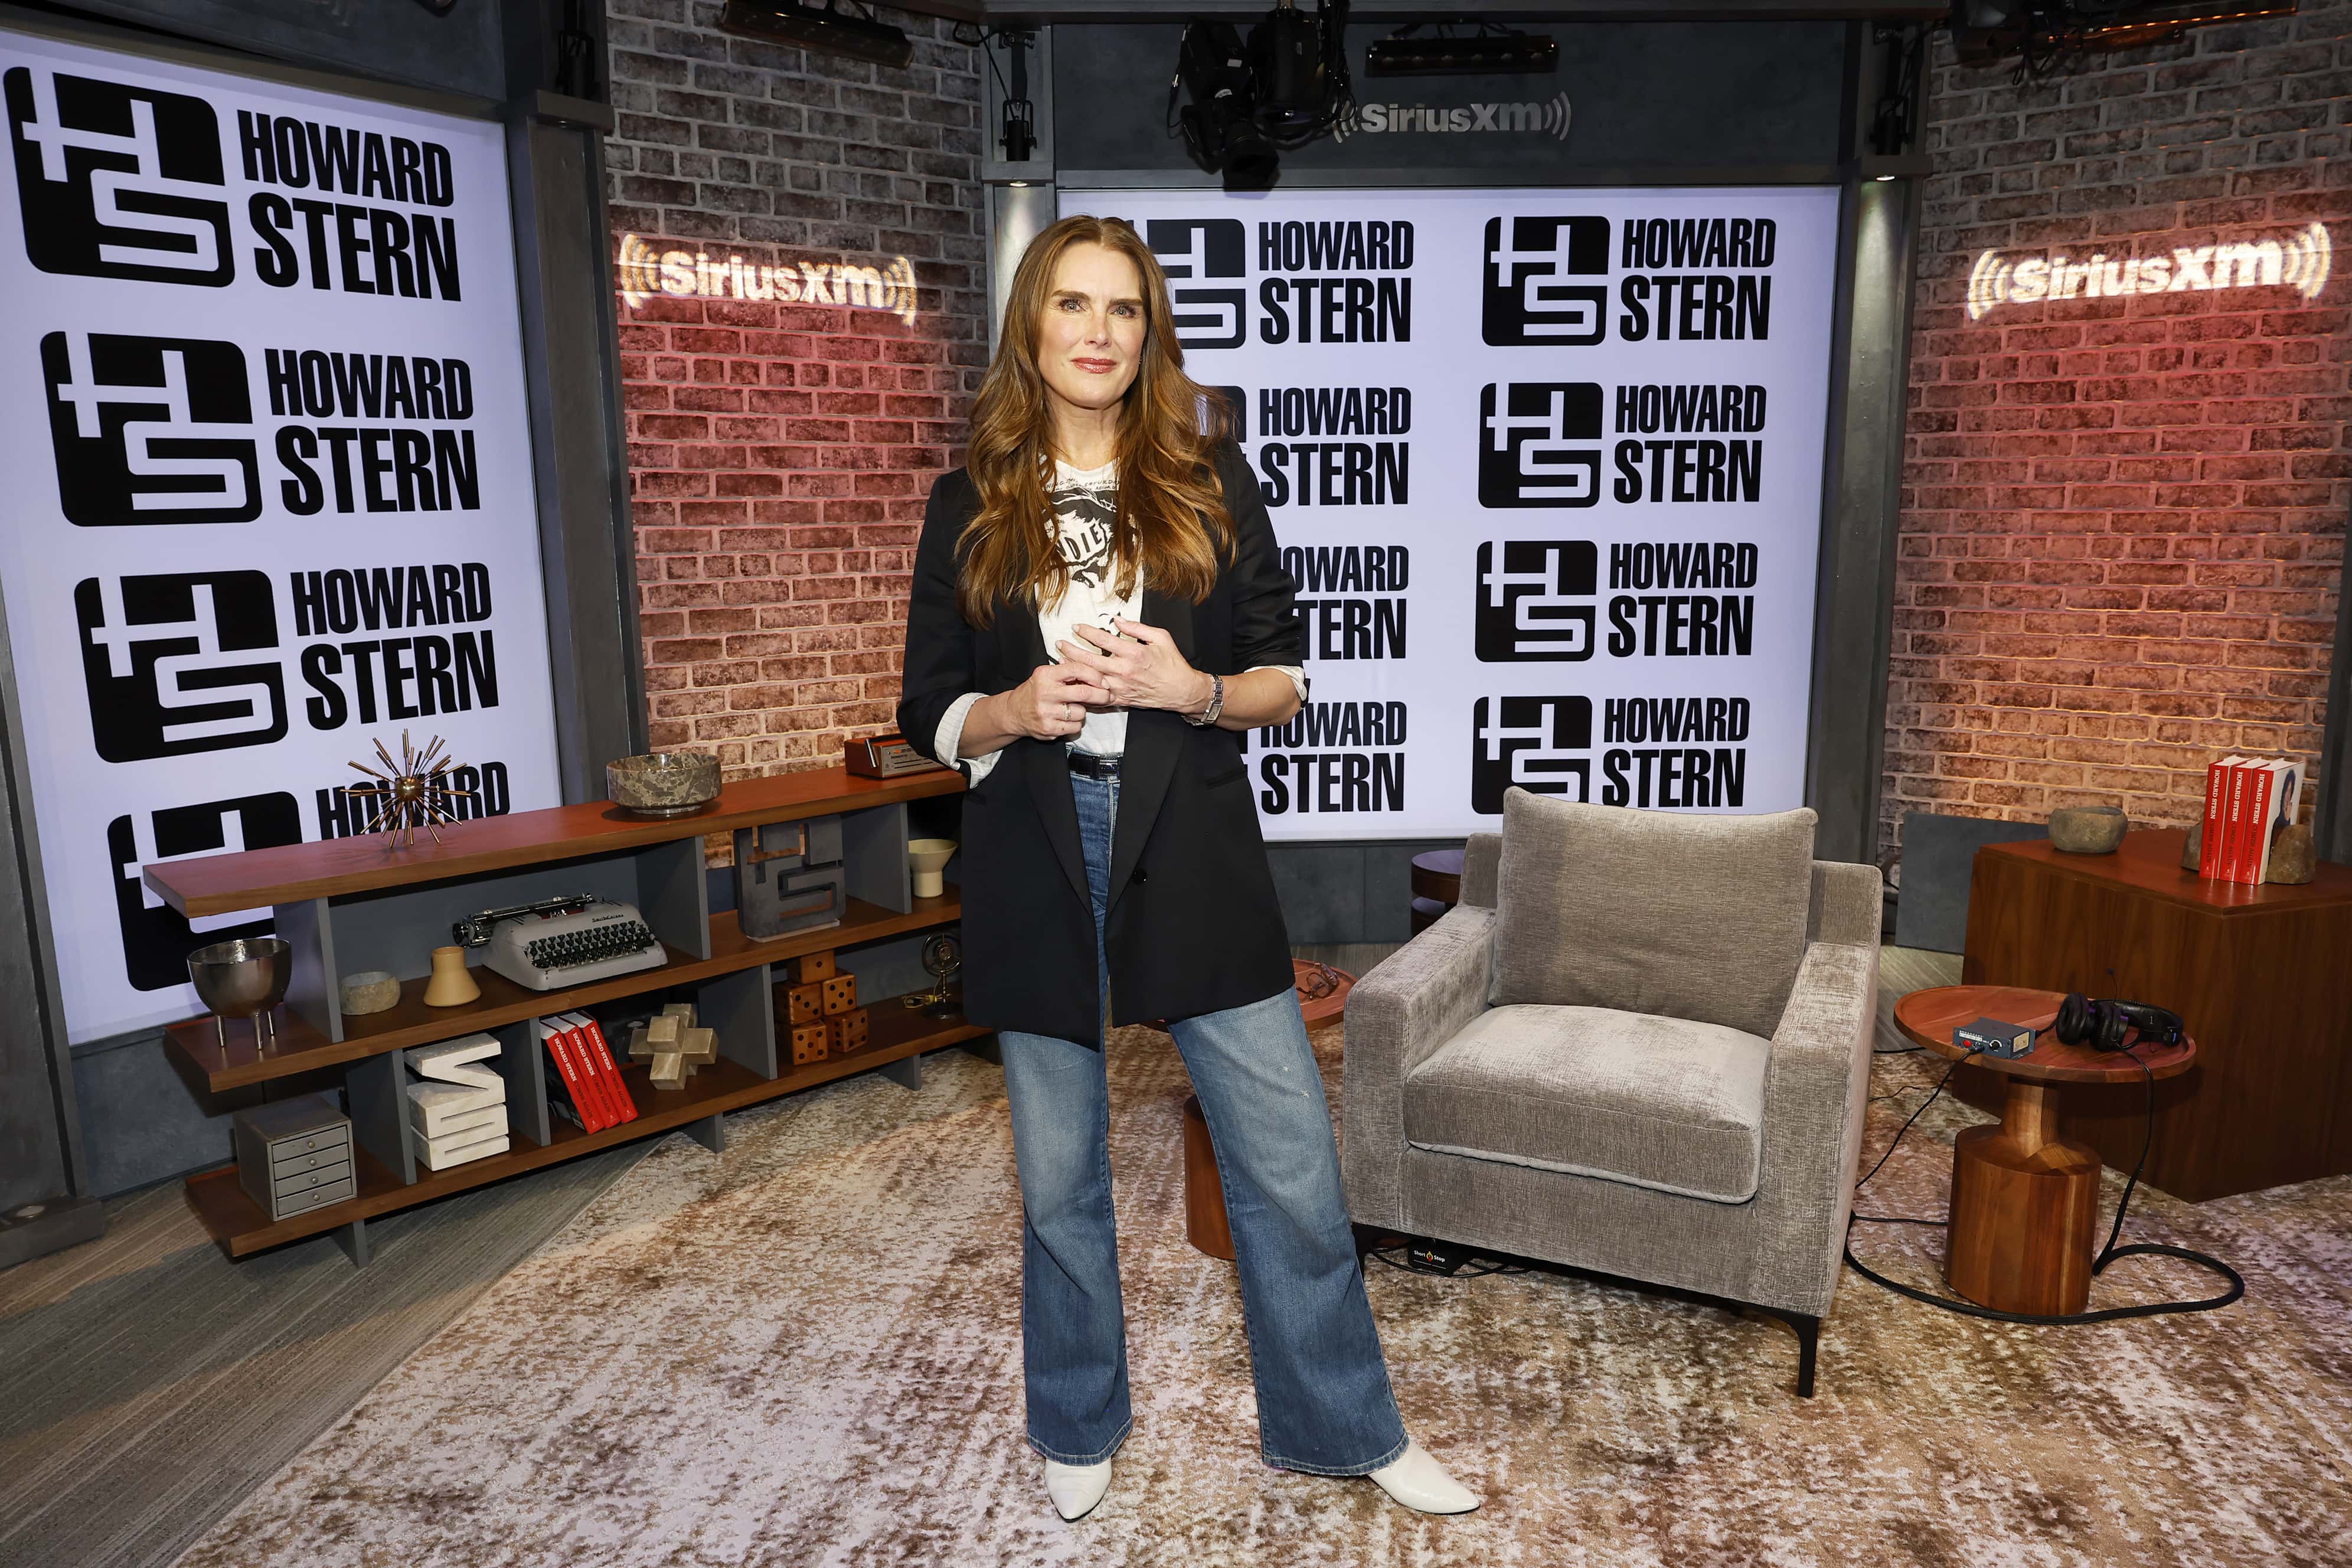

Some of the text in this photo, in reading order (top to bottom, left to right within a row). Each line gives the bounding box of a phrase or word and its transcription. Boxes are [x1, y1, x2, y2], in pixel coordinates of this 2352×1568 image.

[237, 110, 454, 207] HOWARD
[249, 192, 461, 302] STERN
[1259, 221, 1414, 271] HOWARD
[1622, 218, 1776, 269] HOWARD
[1260, 278, 1412, 344] STERN
[1620, 275, 1771, 342] STERN
[264, 349, 473, 420] HOWARD
[1616, 385, 1767, 433] HOWARD
[1260, 388, 1411, 437] HOWARD
[276, 426, 481, 515] STERN
[1260, 443, 1409, 507] STERN
[1614, 440, 1762, 503] STERN
[1280, 546, 1409, 593] OWARD
[1610, 543, 1758, 589] HOWARD
[290, 563, 492, 636] HOWARD
[1293, 599, 1407, 660] TERN
[1608, 596, 1754, 657] STERN
[301, 630, 499, 730] STERN
[1604, 698, 1750, 743] HOWARD
[1261, 753, 1404, 815] STERN
[1603, 749, 1746, 808] STERN
[2212, 769, 2220, 798] HOWARD
[2235, 772, 2243, 800] HOWARD
[2256, 773, 2265, 802] HOWARD
[2232, 800, 2240, 822] STERN
[2252, 802, 2261, 824] STERN
[554, 1037, 568, 1063] HOWARD
[566, 1063, 577, 1082] STERN
[573, 1032, 586, 1057] HOWARD
[584, 1057, 595, 1076] STERN
[590, 1027, 604, 1051] HOWARD
[601, 1051, 612, 1070] STERN
